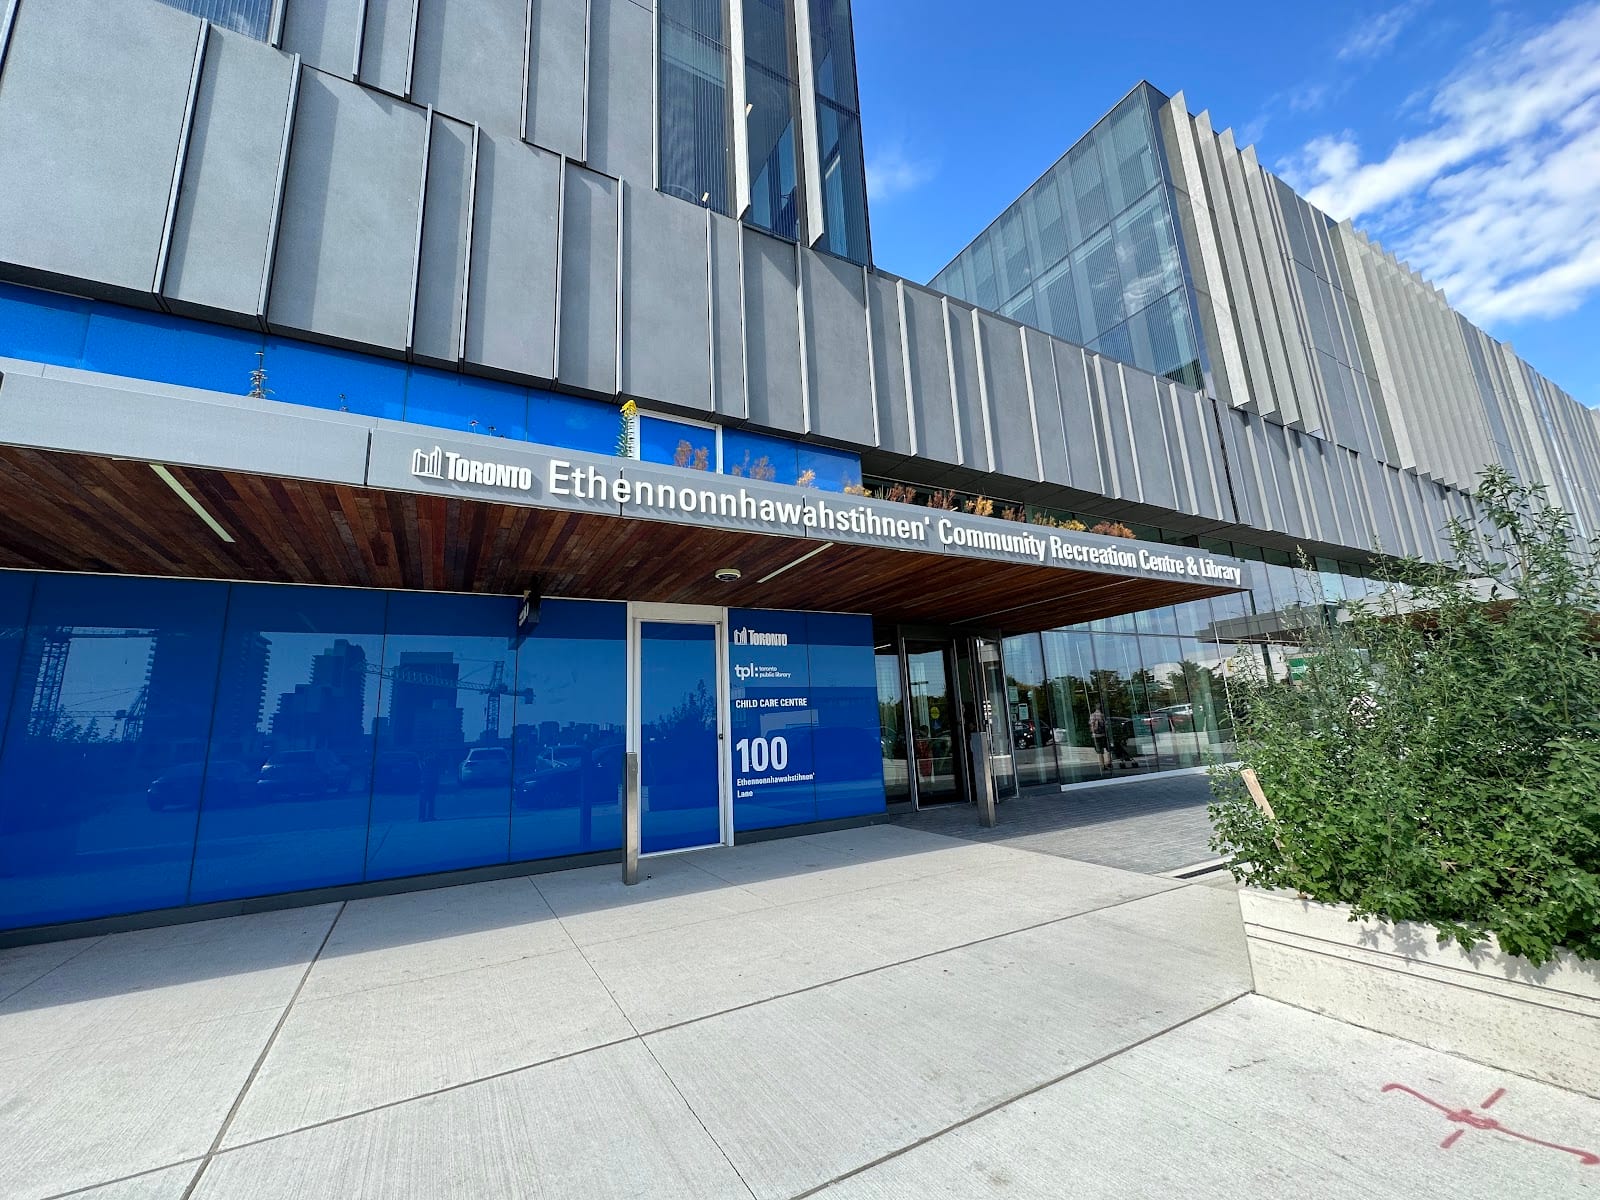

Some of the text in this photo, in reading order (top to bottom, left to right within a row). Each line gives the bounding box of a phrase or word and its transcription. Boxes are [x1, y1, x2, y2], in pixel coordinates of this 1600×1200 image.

[445, 451, 532, 490] TORONTO
[938, 518, 1047, 561] Community
[1050, 538, 1137, 569] Recreation
[1138, 549, 1185, 574] Centre
[1185, 556, 1199, 577] &
[1199, 557, 1241, 585] Library
[748, 629, 788, 646] TORONTO
[775, 671, 792, 679] library
[735, 698, 807, 708] CHILD CARE CENTRE
[736, 736, 788, 773] 100
[737, 790, 754, 798] Lane
